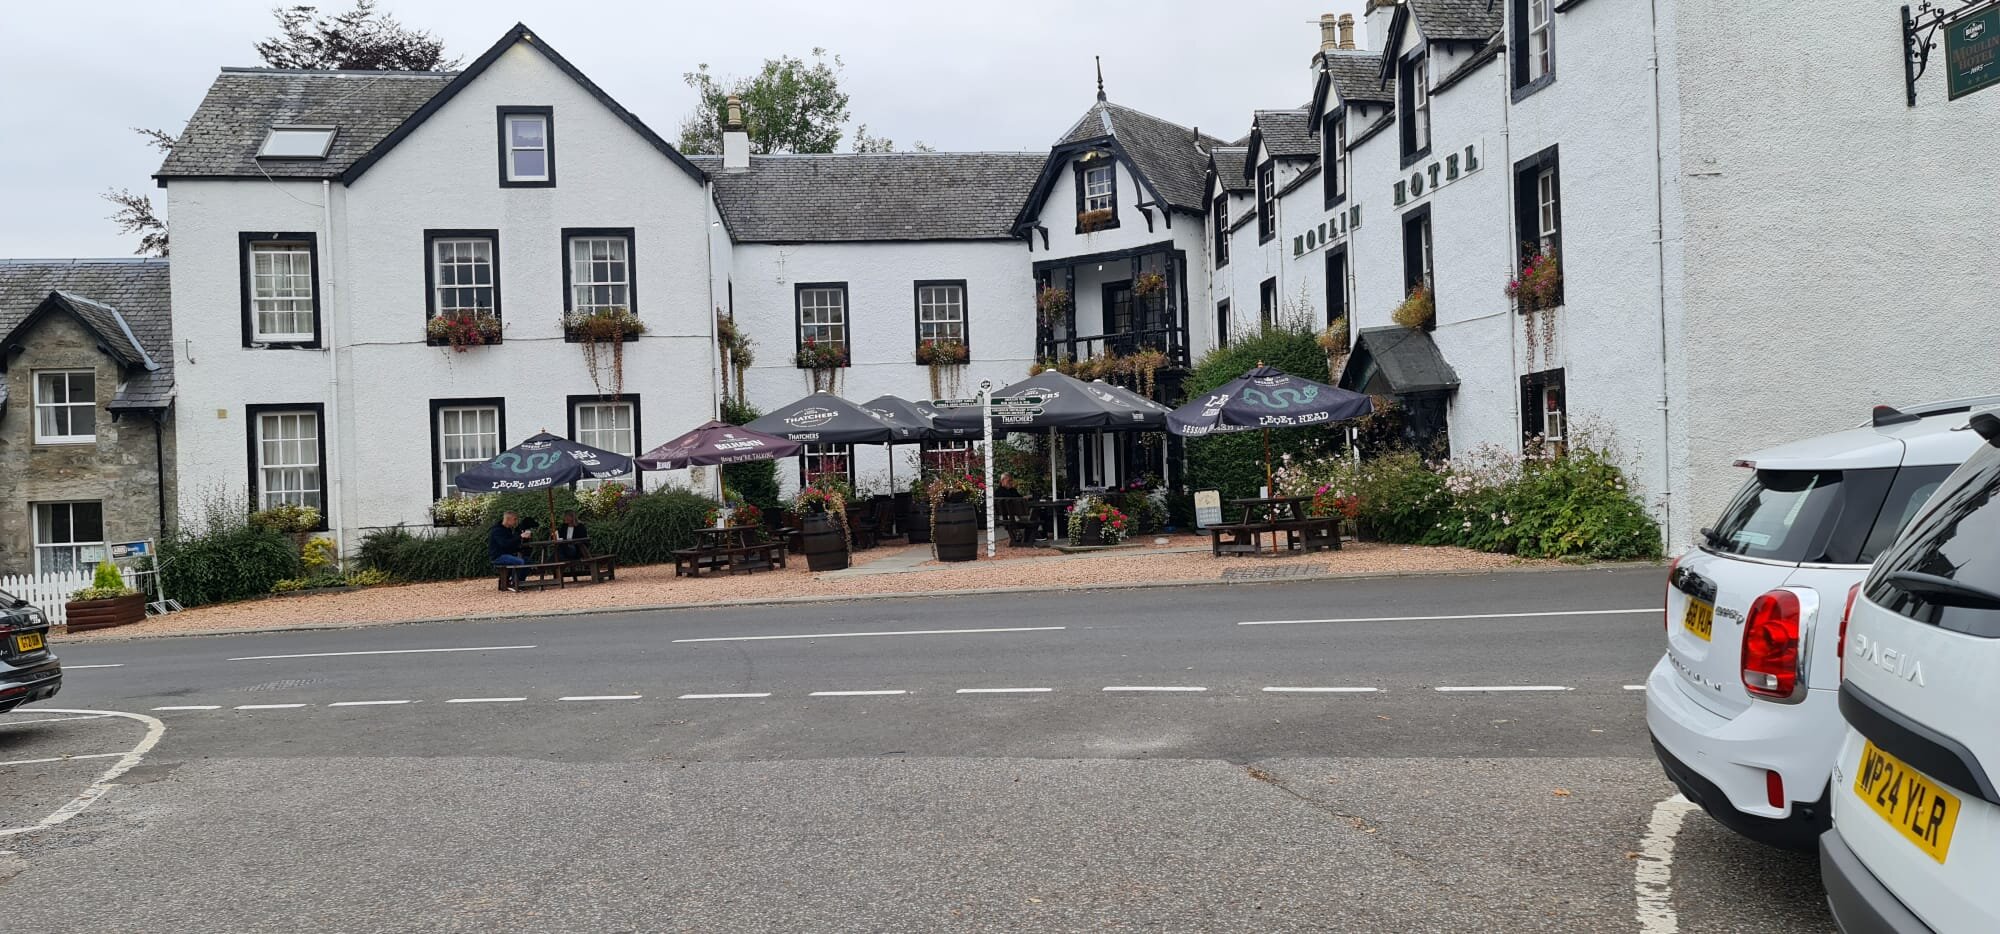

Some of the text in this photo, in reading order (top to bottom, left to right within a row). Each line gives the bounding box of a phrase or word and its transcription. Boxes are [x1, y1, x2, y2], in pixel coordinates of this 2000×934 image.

[1294, 144, 1478, 256] MOULIN HOTEL
[783, 410, 839, 424] THATCHERS
[1002, 415, 1034, 423] THATCHERS
[1298, 411, 1329, 424] HEAD
[788, 432, 820, 441] THATCHERS
[527, 477, 552, 488] HEAD
[1855, 633, 1927, 688] DACIA
[1861, 747, 1946, 848] WP24 YLR
